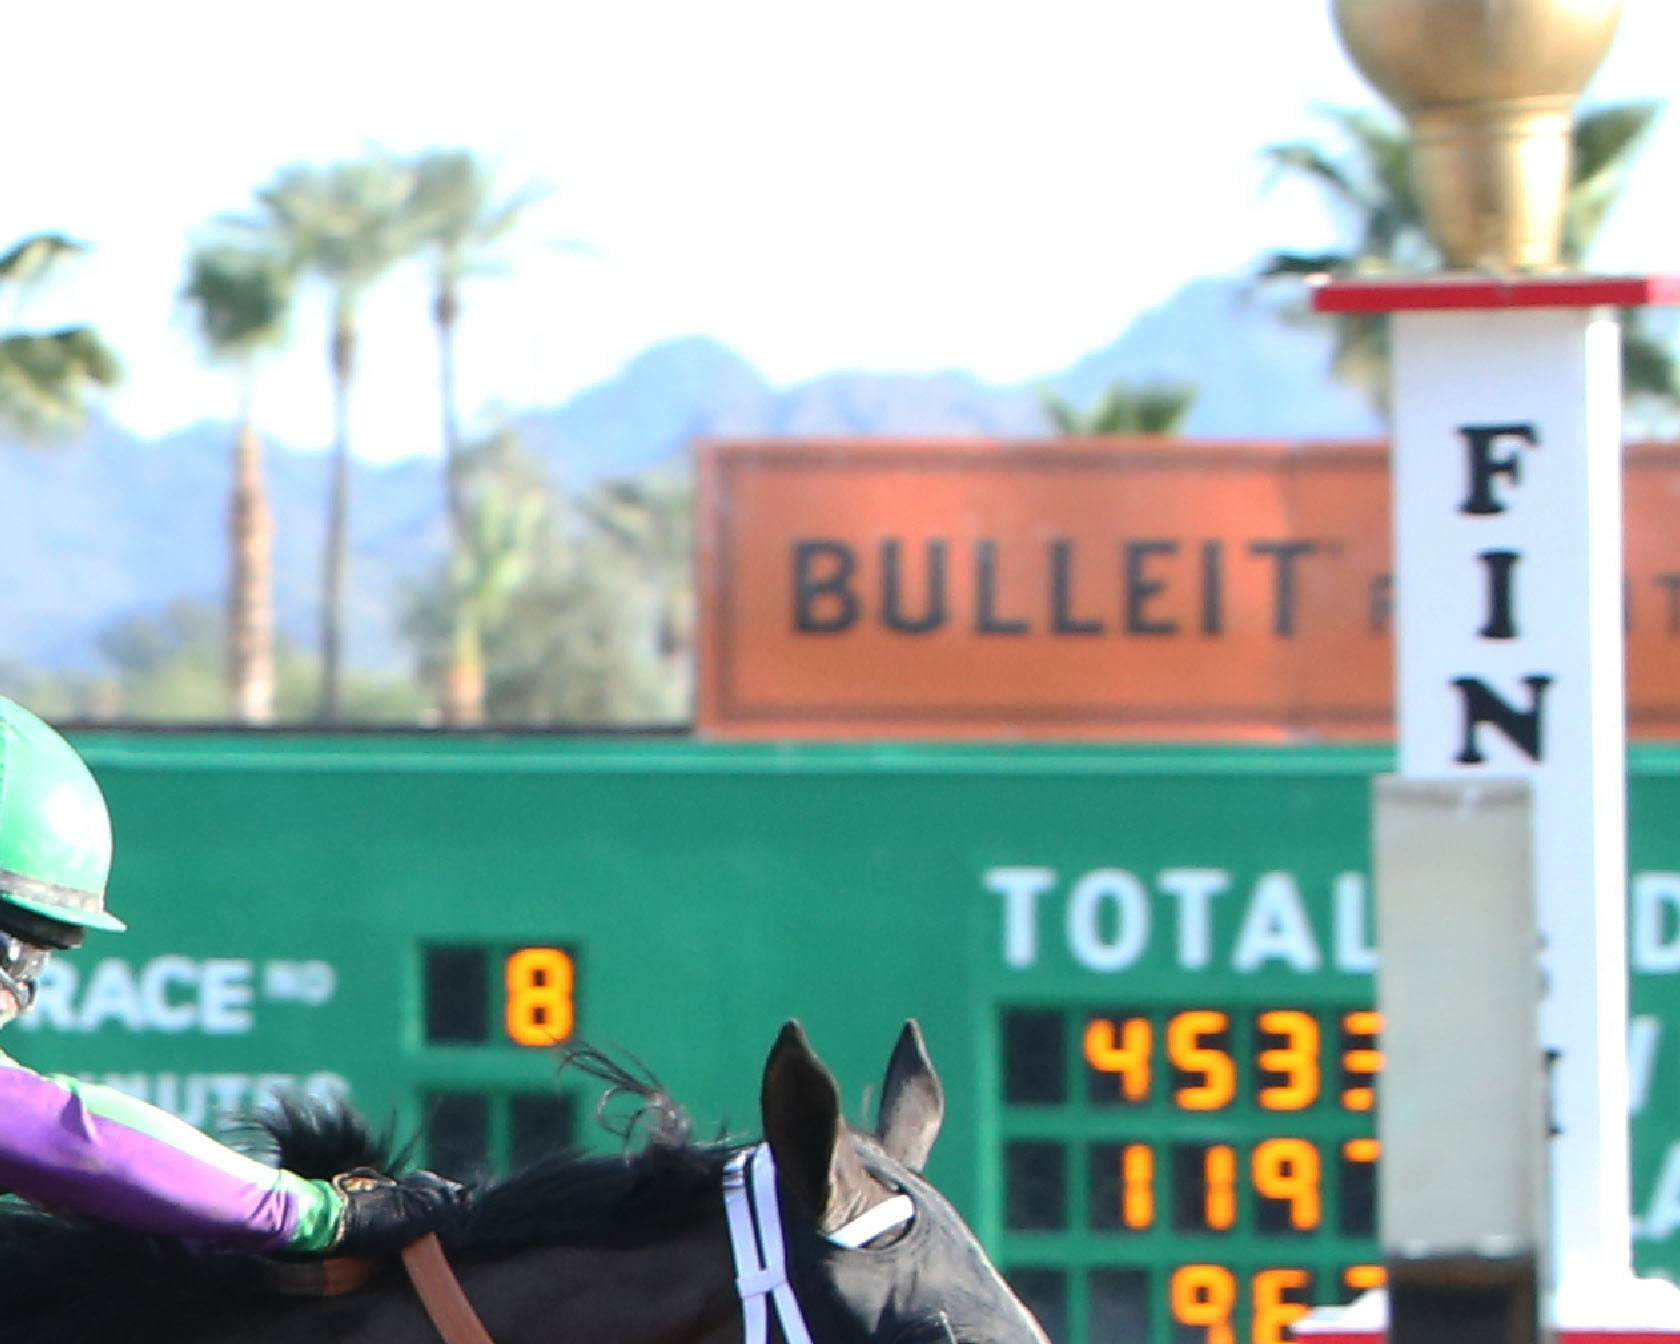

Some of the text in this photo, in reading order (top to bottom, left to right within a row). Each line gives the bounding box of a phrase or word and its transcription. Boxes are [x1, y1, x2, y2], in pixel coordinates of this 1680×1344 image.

[790, 538, 1318, 638] BULLEIT
[982, 867, 1382, 973] TOTAL
[20, 953, 256, 1034] RACE
[505, 947, 574, 1046] 8
